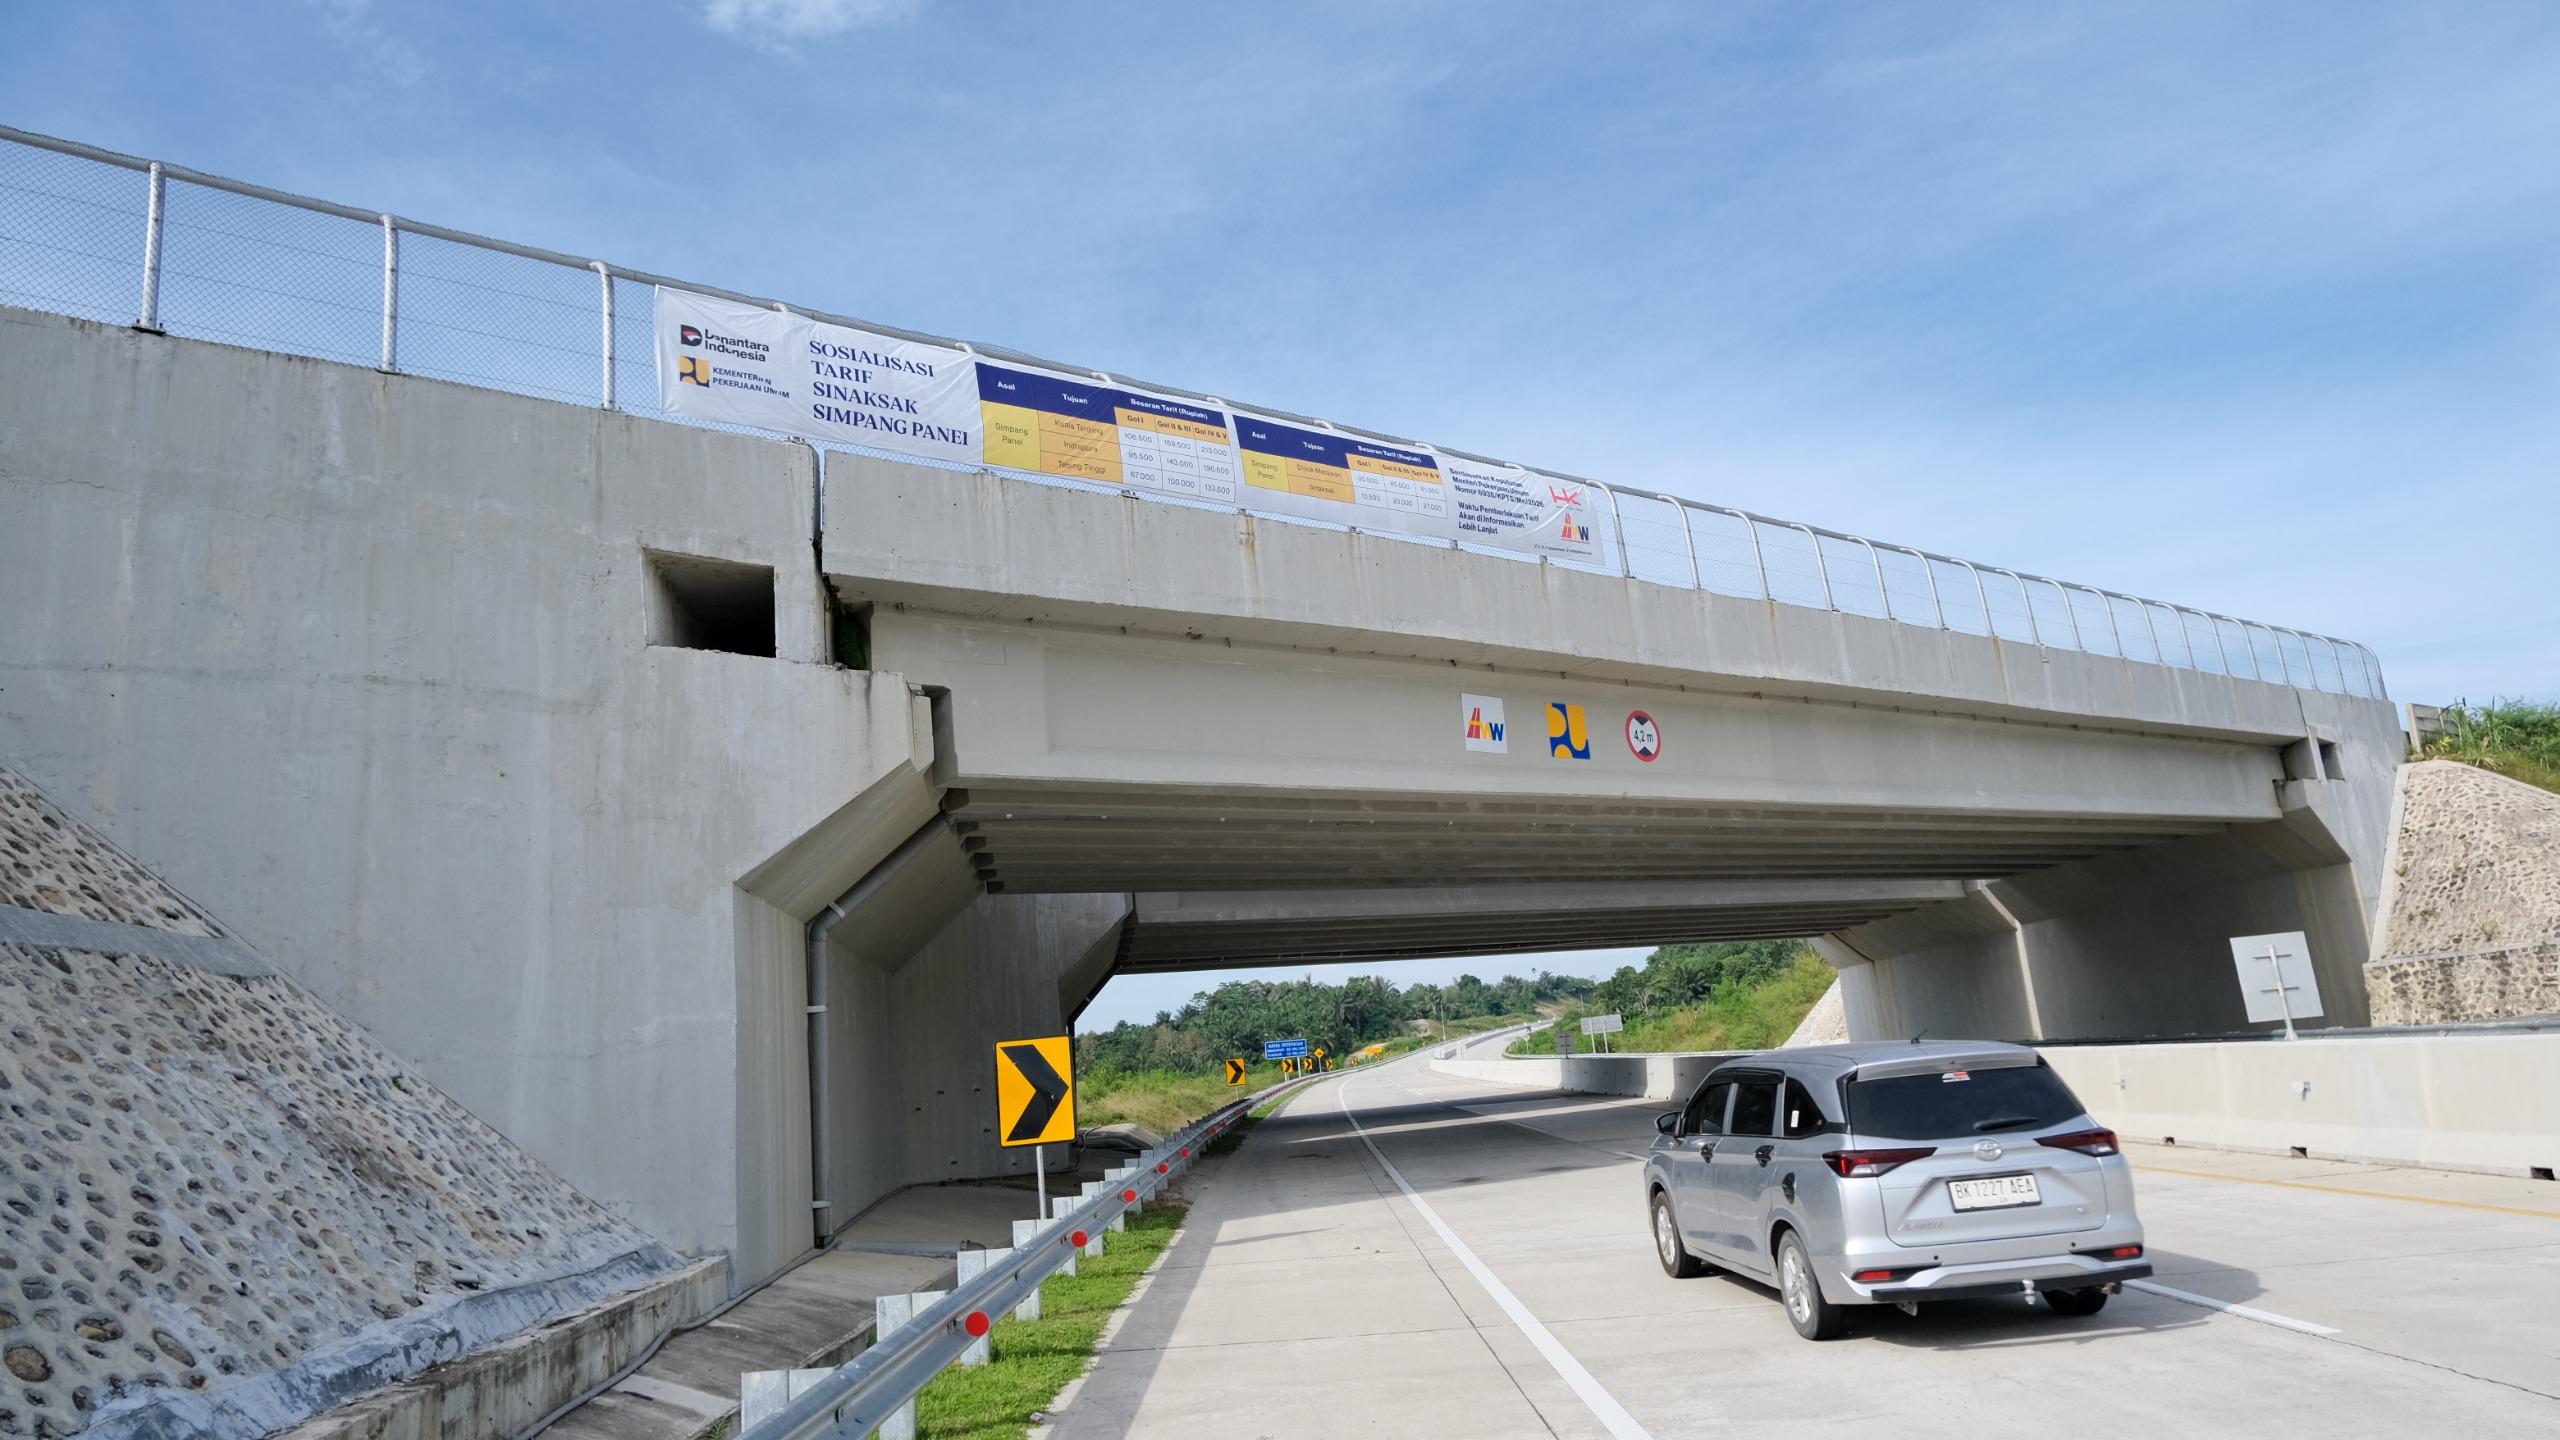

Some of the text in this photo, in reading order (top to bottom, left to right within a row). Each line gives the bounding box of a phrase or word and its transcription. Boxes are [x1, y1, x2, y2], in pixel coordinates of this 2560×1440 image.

[810, 341, 935, 377] SOSIALISASI
[811, 360, 872, 384] TARIF
[713, 377, 762, 392] PEKERJAAN
[998, 381, 1016, 390] Asal
[813, 382, 918, 414] SINAKSAK
[1062, 394, 1088, 404] Tujuan
[1130, 398, 1208, 420] Besaran Tarif (Rupiah)
[813, 404, 968, 446] SIMPANG PANEI
[995, 422, 1028, 436] Simpang
[1002, 435, 1023, 446] Panei
[1064, 441, 1098, 452] Indrapura
[1202, 446, 1227, 456] 213.000
[1084, 464, 1106, 474] Tinggi
[1168, 478, 1195, 488] 100.000
[1455, 485, 1476, 495] Nomor
[1458, 501, 1479, 512] Waktu
[1480, 506, 1524, 519] Pemberlakuan
[1459, 512, 1475, 520] Akan
[1483, 515, 1524, 528] Informasikan
[1459, 521, 1498, 534] Lebih Lanjut
[1647, 734, 1653, 742] m
[1955, 1178, 2033, 1199] BK 1227 AEA
